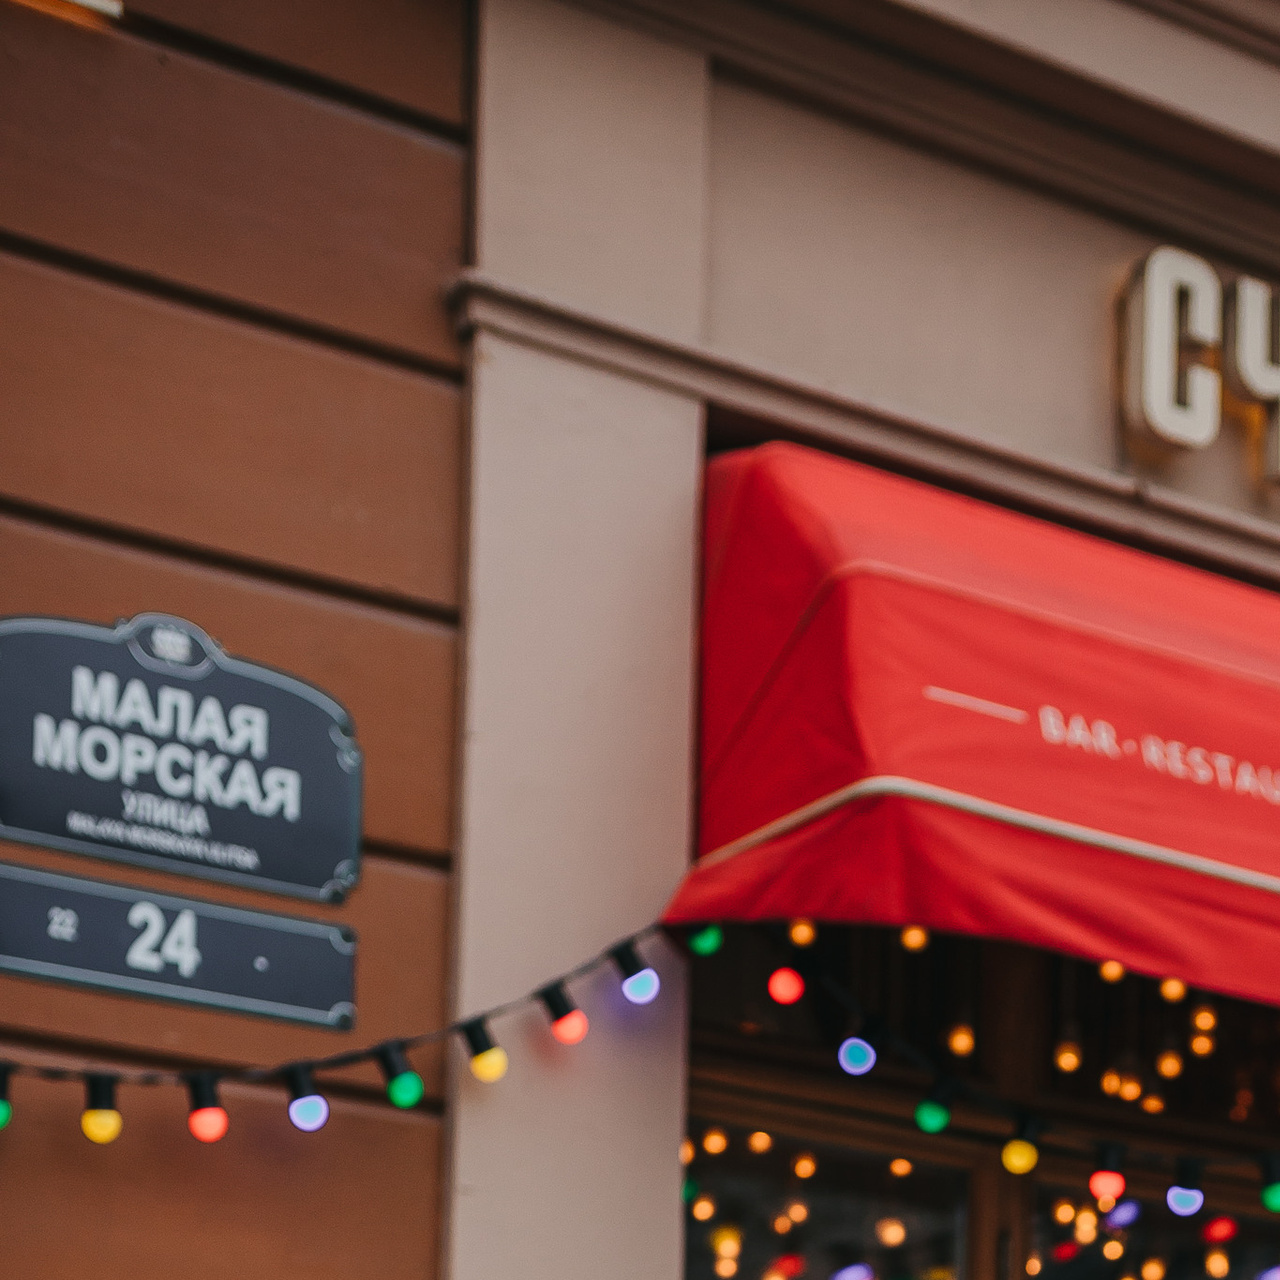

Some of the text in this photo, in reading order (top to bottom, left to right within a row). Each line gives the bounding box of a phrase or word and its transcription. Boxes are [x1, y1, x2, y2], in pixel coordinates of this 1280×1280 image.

[71, 665, 270, 760] МАЛАЯ
[32, 713, 302, 823] МОРСКАЯ
[126, 901, 201, 978] 24
